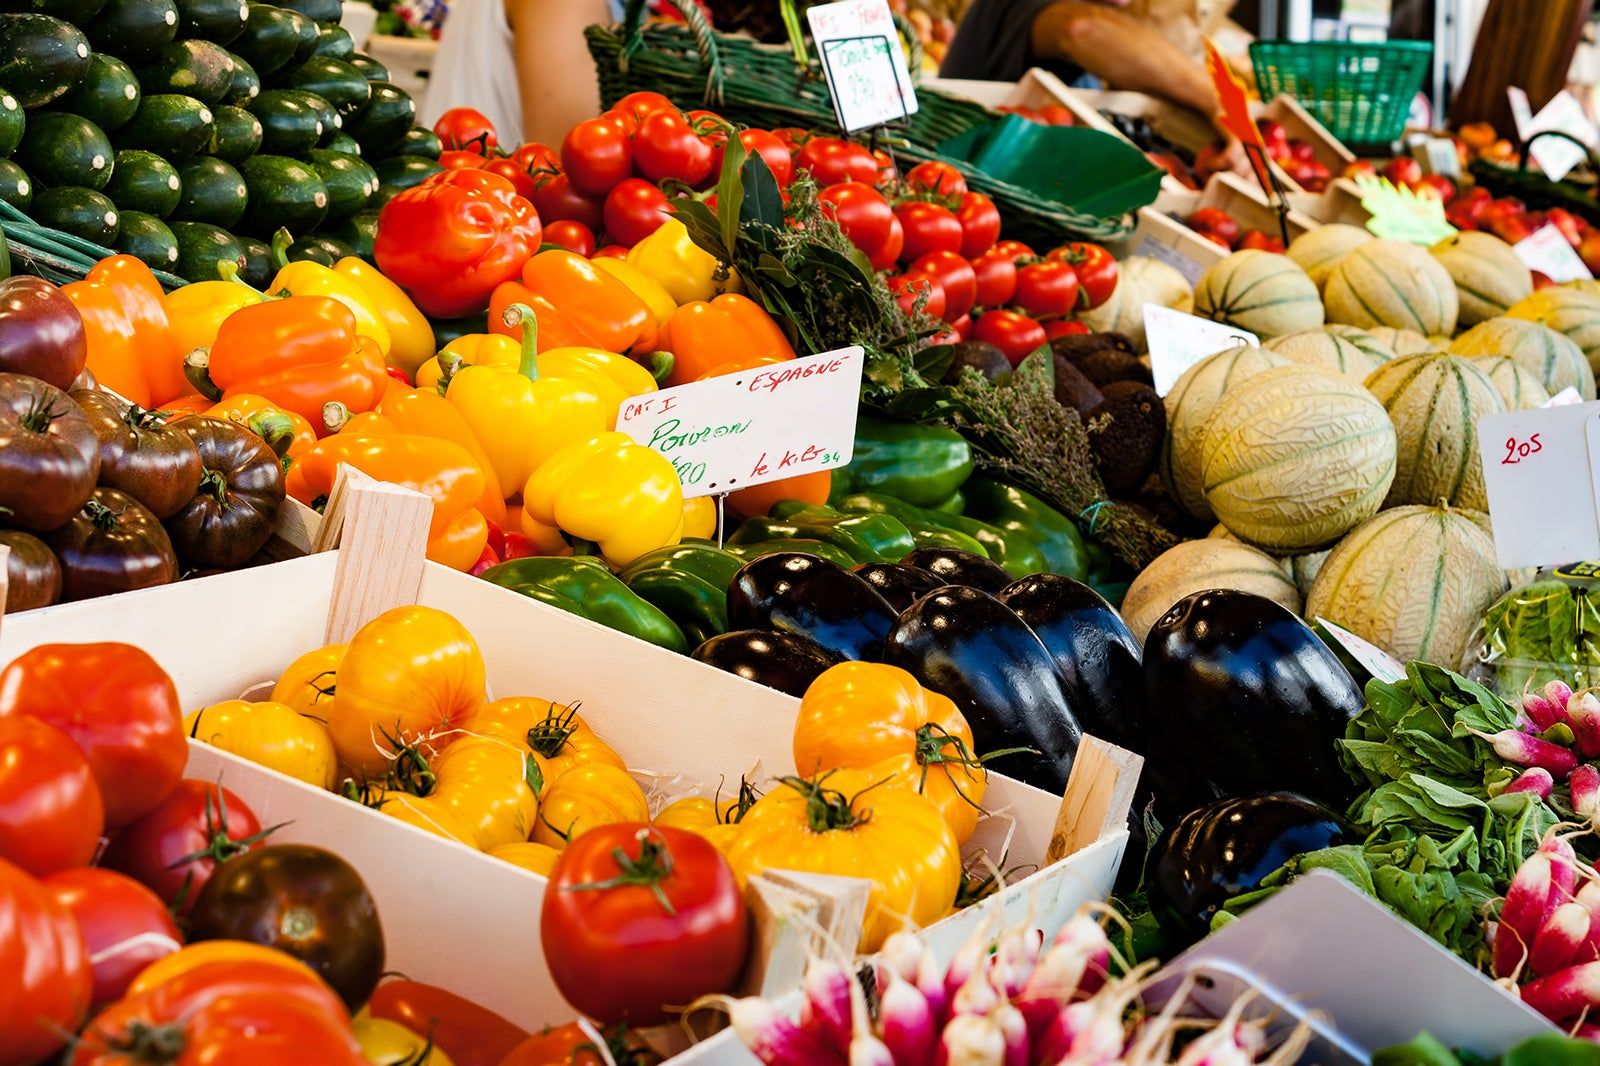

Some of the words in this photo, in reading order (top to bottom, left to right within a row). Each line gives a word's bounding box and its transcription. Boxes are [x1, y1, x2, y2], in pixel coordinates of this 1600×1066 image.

[748, 355, 850, 392] ESPAGNE
[623, 399, 655, 421] CAT
[657, 396, 678, 415] I
[1501, 432, 1543, 465] 205
